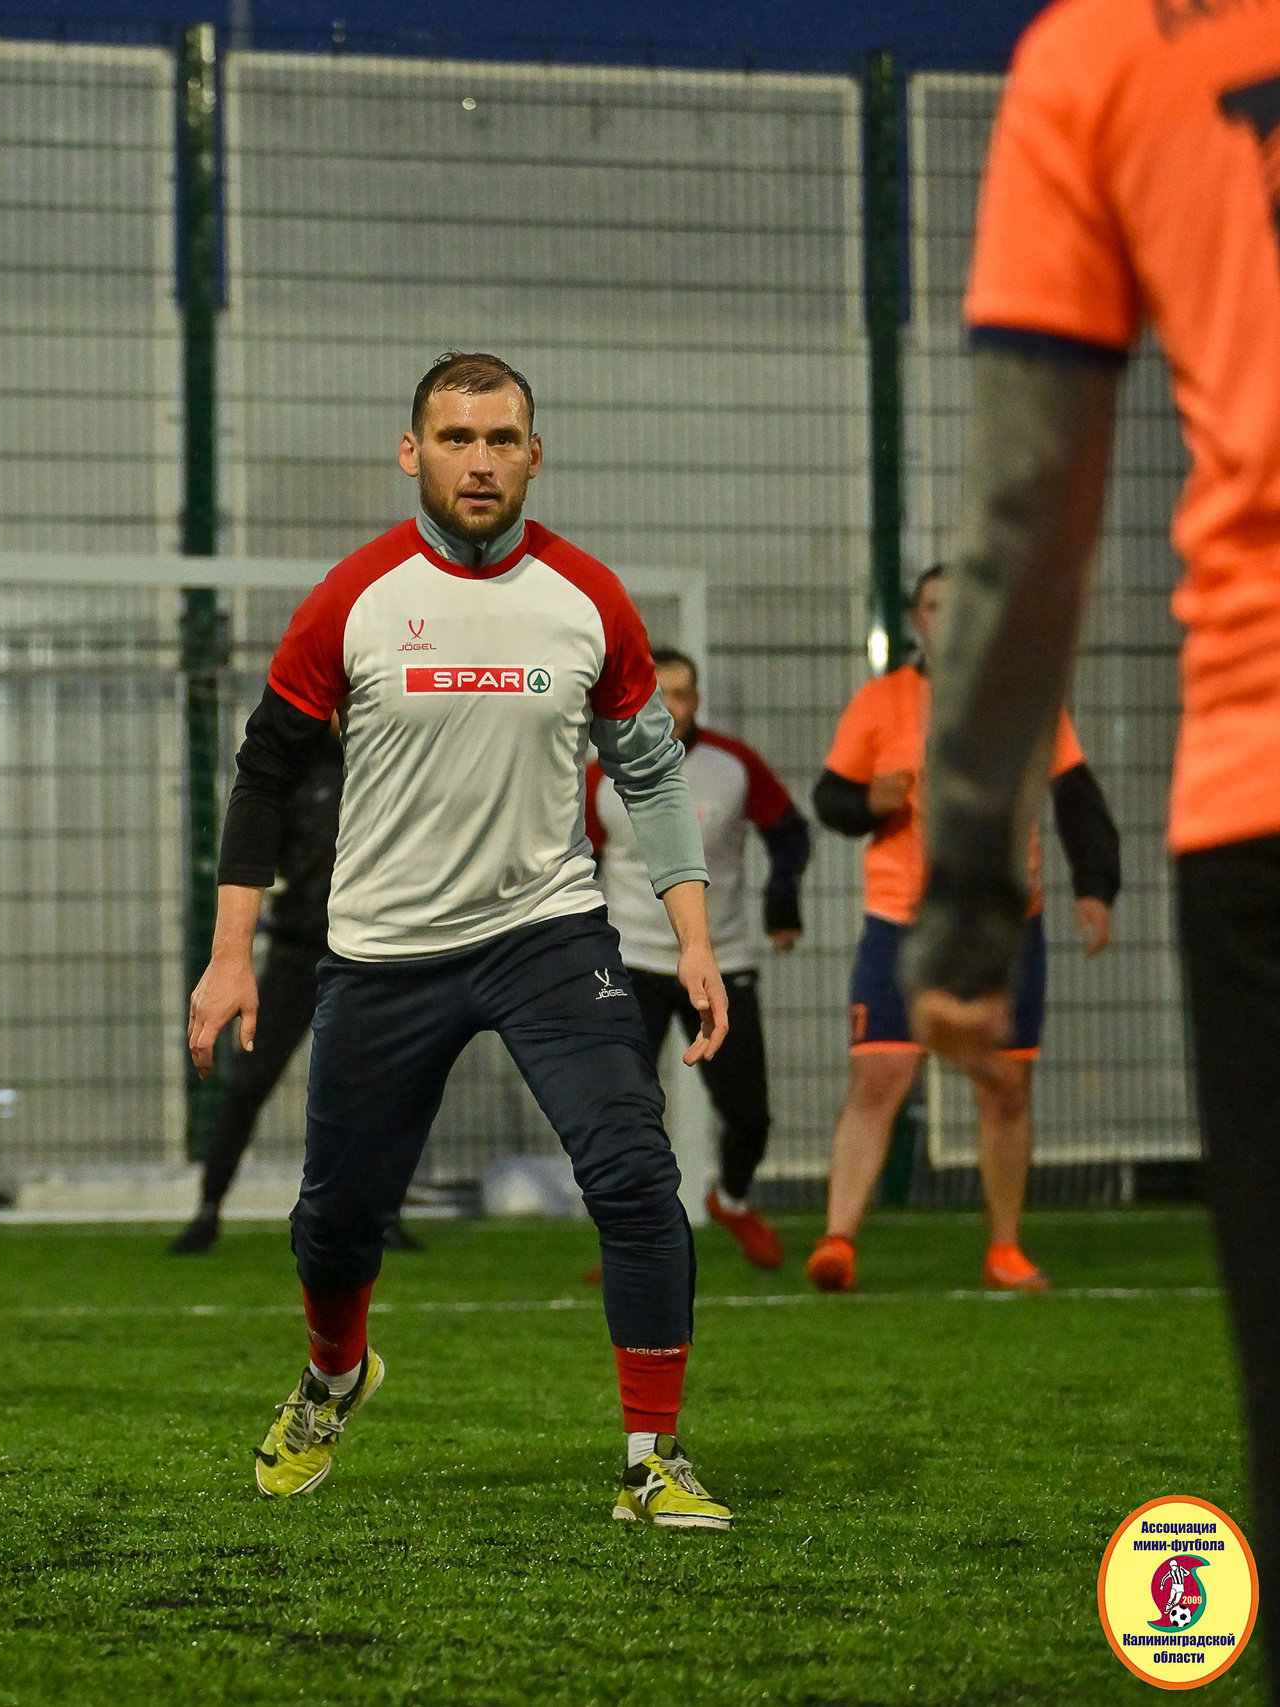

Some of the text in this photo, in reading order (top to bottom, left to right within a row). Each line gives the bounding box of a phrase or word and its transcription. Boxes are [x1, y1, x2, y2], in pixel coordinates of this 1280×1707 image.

[397, 642, 437, 651] JÖGEL
[433, 671, 520, 688] SPAR
[595, 988, 628, 1000] JÖGEL
